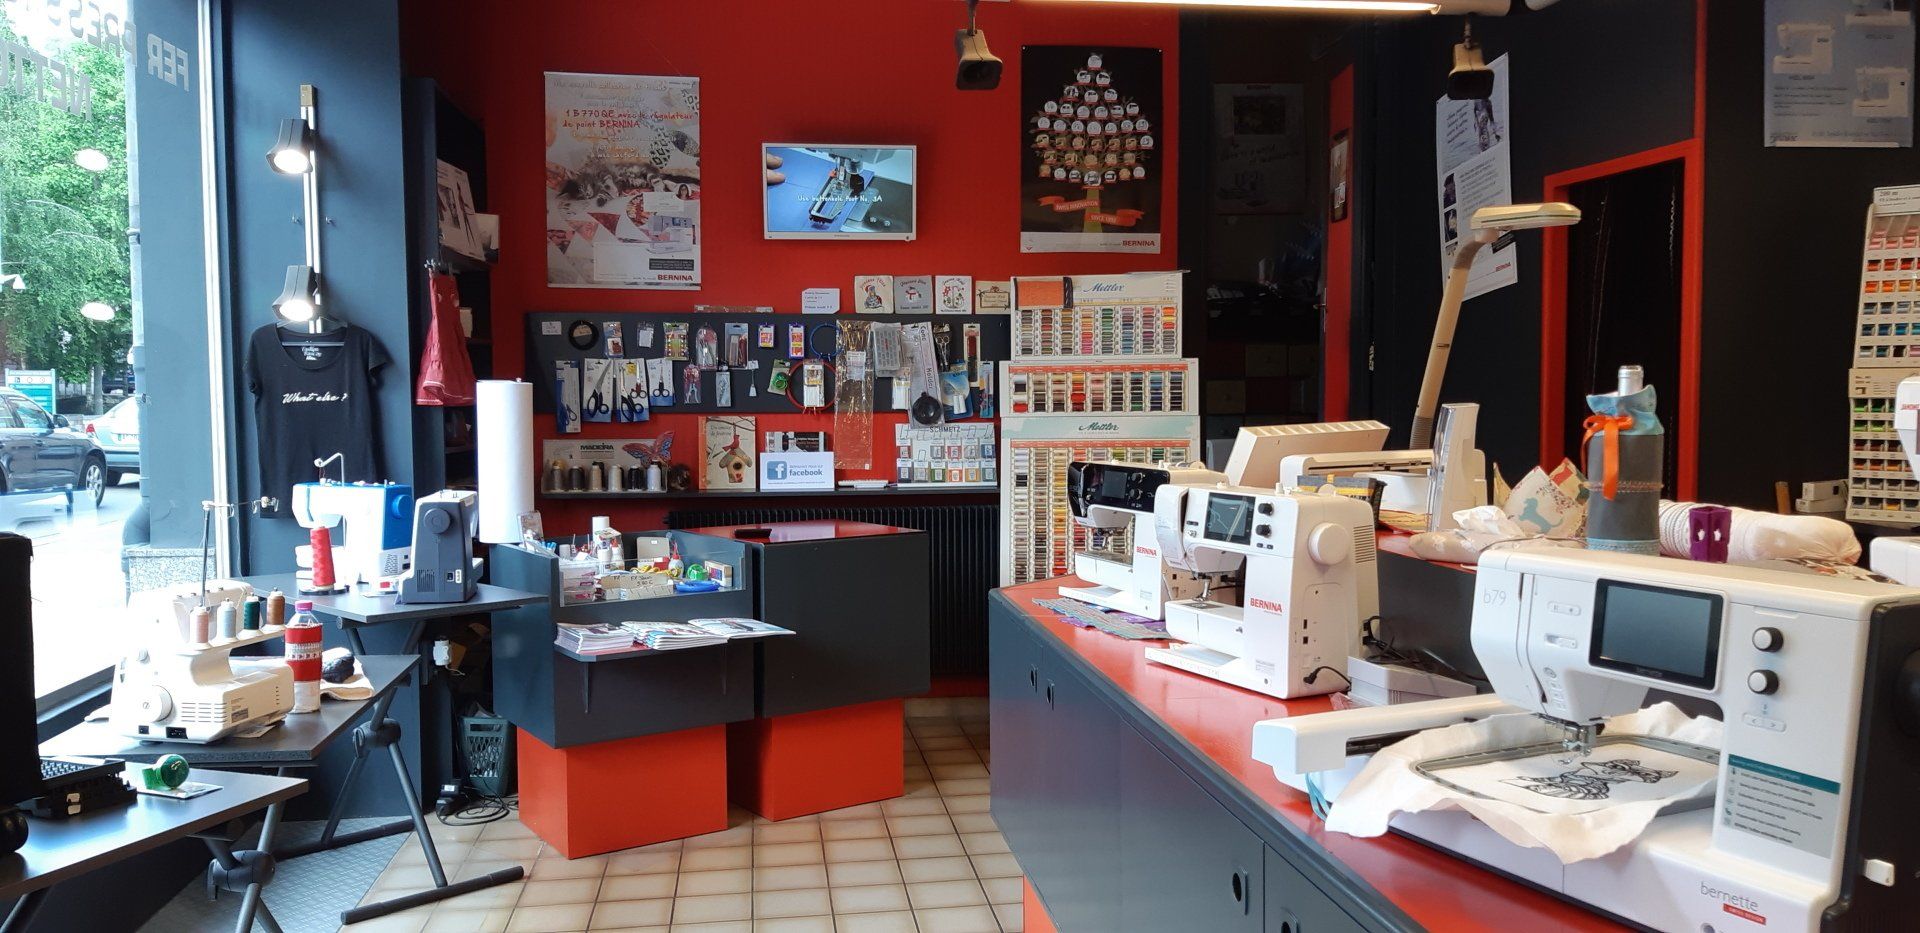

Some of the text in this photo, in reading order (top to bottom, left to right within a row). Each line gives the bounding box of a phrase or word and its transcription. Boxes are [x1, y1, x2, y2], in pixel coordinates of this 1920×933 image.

[582, 110, 600, 118] 770
[576, 121, 596, 130] point
[600, 120, 641, 129] BERNINA
[1083, 281, 1125, 293] Mettler
[282, 391, 348, 404] What else ?
[1079, 421, 1119, 431] Mettler
[789, 469, 823, 477] facebook
[1136, 546, 1157, 556] BERNINA
[1483, 586, 1506, 606] b79
[1250, 597, 1282, 613] BERNINA
[1700, 881, 1759, 912] bernette
